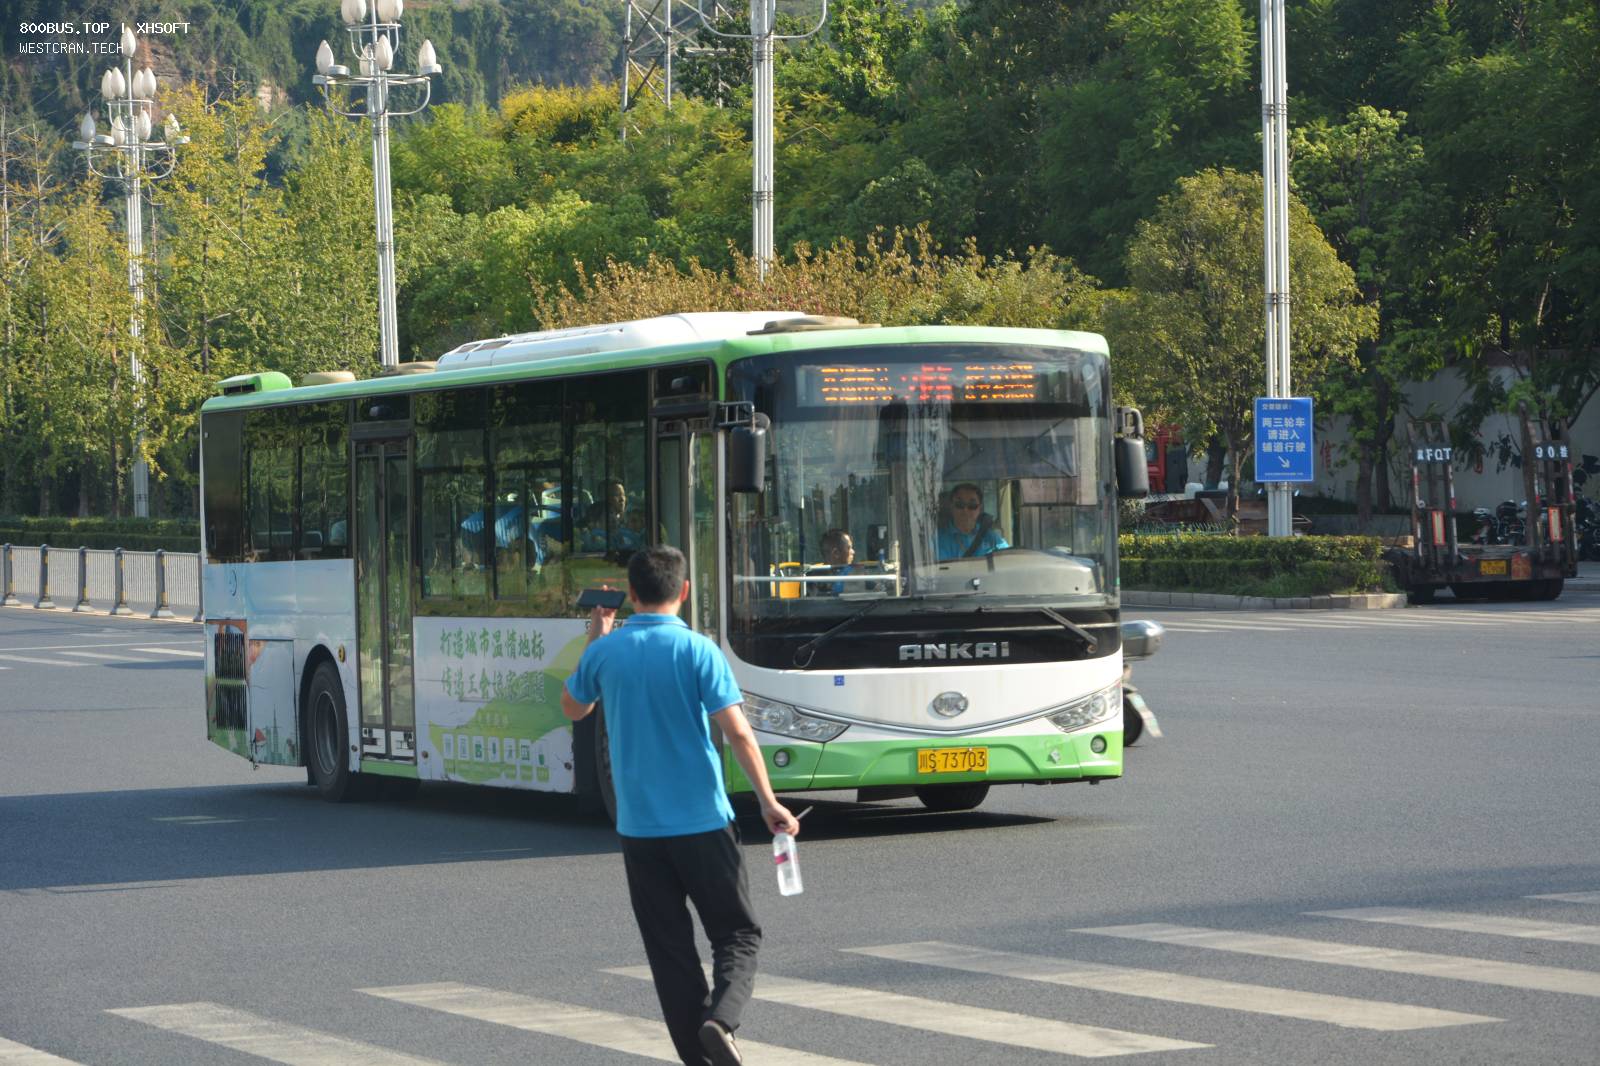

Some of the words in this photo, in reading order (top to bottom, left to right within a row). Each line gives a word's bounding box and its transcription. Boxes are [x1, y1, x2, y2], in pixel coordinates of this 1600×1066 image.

[1262, 417, 1305, 428] 两三轮车
[1267, 429, 1300, 440] 请进入
[1262, 442, 1306, 452] 辅道行驶
[440, 627, 545, 661] 打造城市温情地标
[898, 641, 1010, 661] ANKAI
